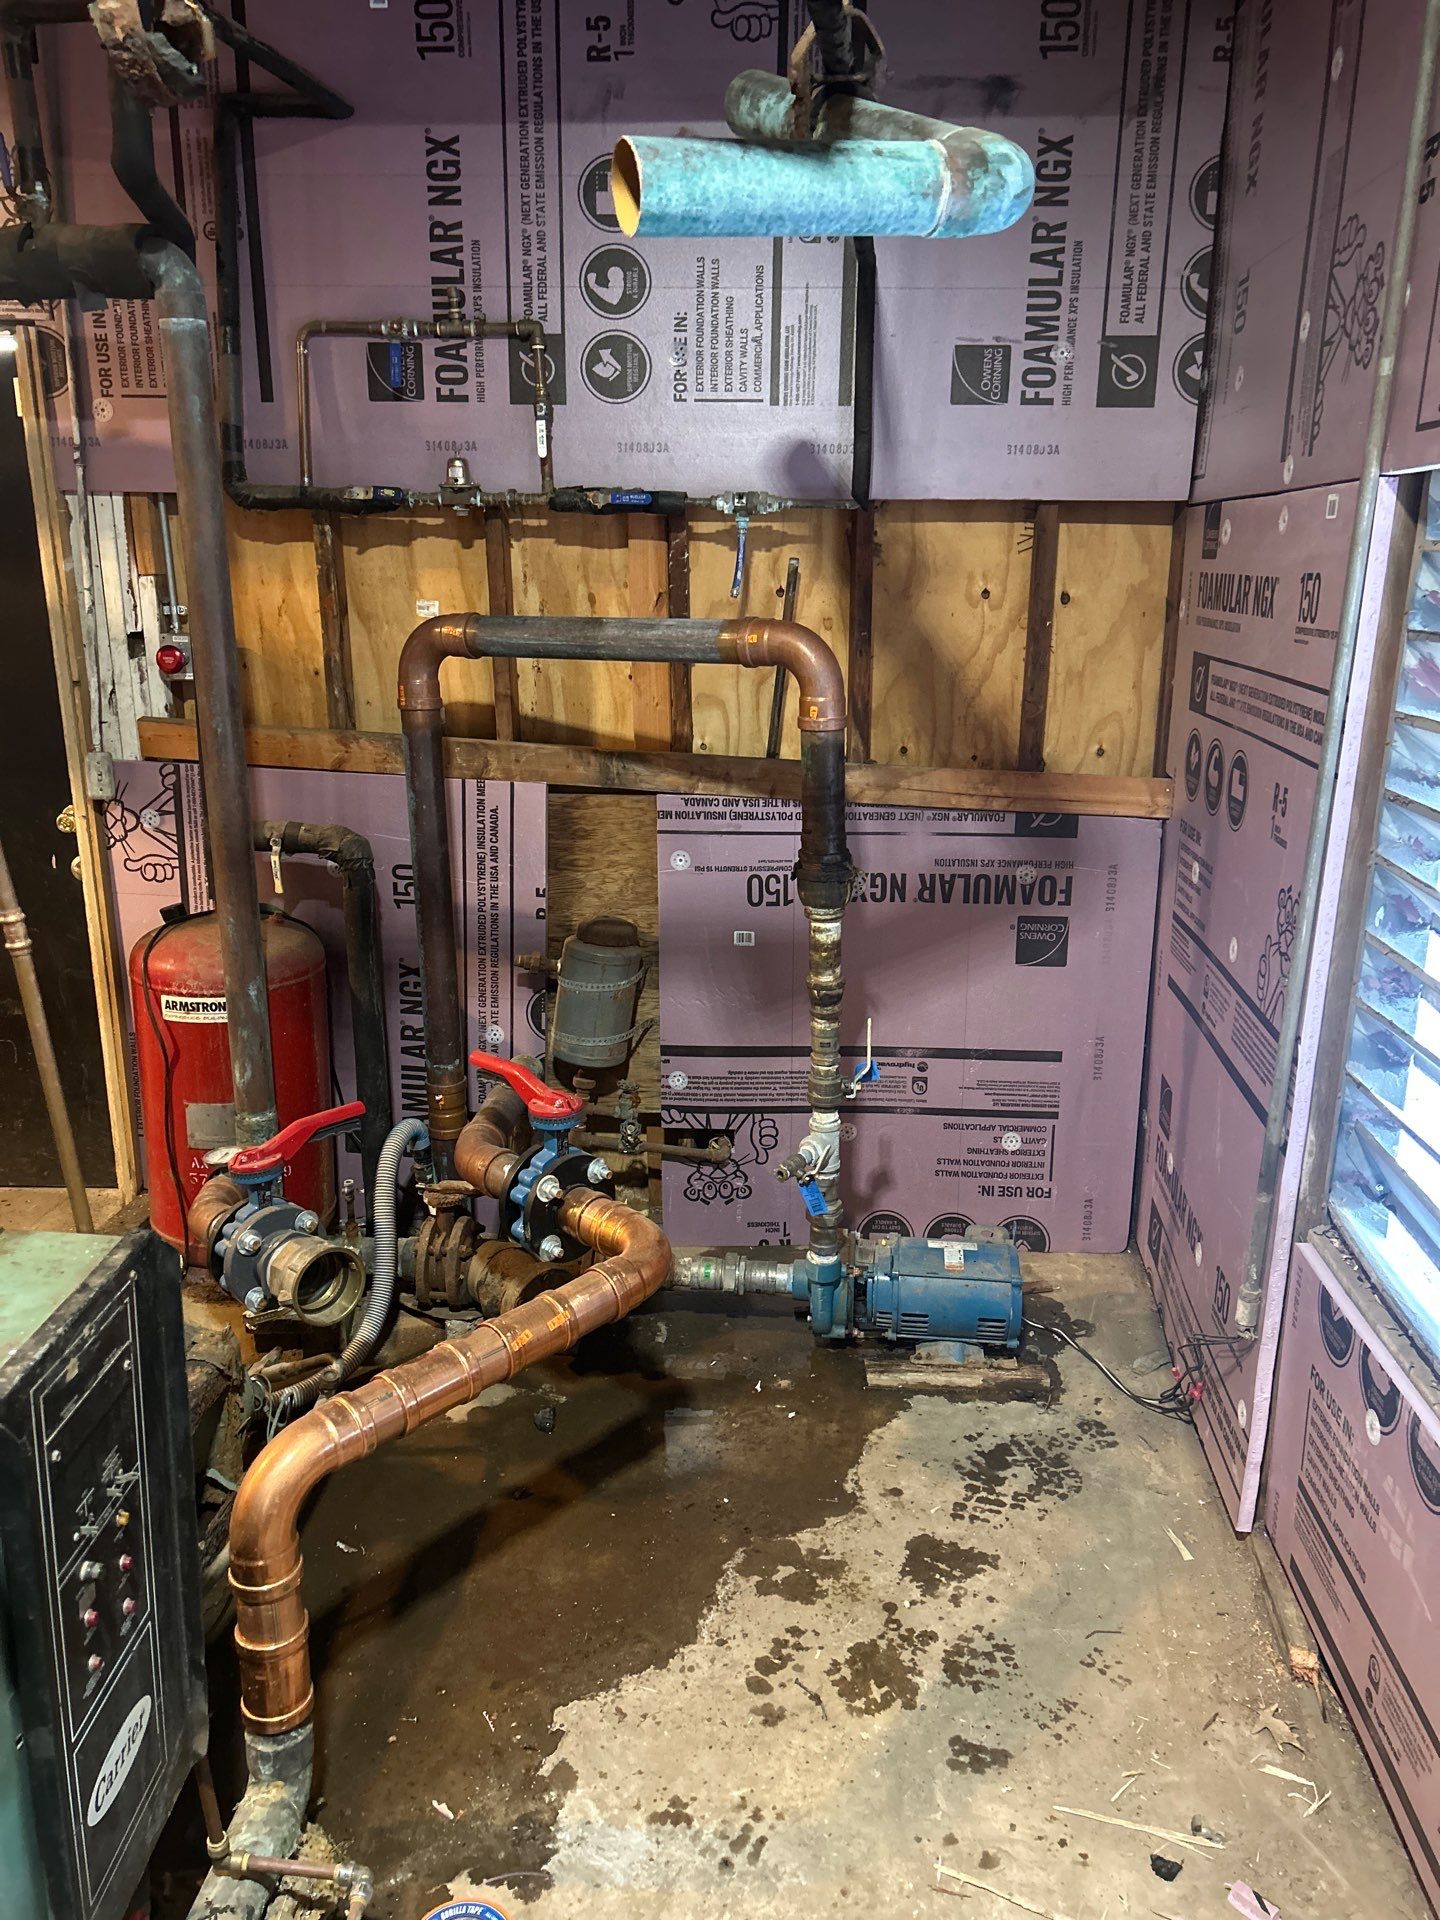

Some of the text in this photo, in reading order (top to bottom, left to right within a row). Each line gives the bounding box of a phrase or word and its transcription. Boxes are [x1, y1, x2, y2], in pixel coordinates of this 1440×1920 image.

[414, 0, 454, 60] 150
[586, 15, 611, 63] R-5
[516, 60, 529, 118] EXTRUDED
[531, 56, 544, 133] REGULATIONS
[518, 120, 531, 190] GENERATION
[533, 136, 545, 190] EMISSION
[1130, 119, 1148, 190] GENERATION
[1146, 136, 1161, 190] EMISSION
[535, 192, 546, 228] STATE
[1142, 191, 1156, 228] STATE
[536, 229, 546, 252] AND
[1139, 230, 1152, 253] AND
[471, 239, 482, 293] INSULATION
[536, 254, 548, 302] FEDERAL
[1135, 255, 1151, 302] FEDERAL
[537, 305, 548, 321] ALL
[695, 256, 705, 393] EXTERIOR FOUNDATION WALLS
[709, 258, 720, 393] INTERIOR FOUNDATION WALLS
[752, 264, 764, 393] COMMERCIAL APPLICATIONS
[1060, 239, 1083, 407] HIGH XPS INSULATION
[1133, 305, 1146, 324] ALL
[94, 332, 114, 398] FOR USE
[724, 296, 734, 393] EXTERIOR SHEATHING
[738, 327, 749, 393] CAVITY WALLS
[117, 346, 130, 389] EXTERIOR
[131, 348, 144, 389] INTERIOR
[145, 346, 158, 389] EXTERIOR
[405, 345, 417, 397] CORNING
[673, 371, 687, 403] FOR
[981, 347, 993, 391] OWENS
[990, 348, 1004, 401] CORNING
[475, 380, 486, 403] HIGH
[1298, 572, 1321, 624] 150
[674, 809, 794, 821] POLYSTYRENE) INSULATION
[721, 798, 740, 808] AND
[740, 798, 760, 808] USA
[1272, 782, 1288, 818] R-5
[475, 798, 486, 849] INSULATION
[489, 845, 500, 864] AND
[489, 865, 500, 883] USA
[934, 858, 979, 868] INSULATION
[980, 858, 995, 868] XPS
[1055, 860, 1075, 870] HIGH
[475, 851, 488, 913] POLYSTYRENE)
[489, 884, 500, 900] THE
[746, 873, 794, 908] 150
[476, 914, 487, 956] EXTRUDED
[489, 912, 500, 969] REGULATIONS
[1019, 922, 1065, 933] CORNING
[1019, 932, 1057, 942] OWENS
[476, 958, 488, 1008] GENERATION
[489, 970, 500, 1009] EMISSION
[165, 999, 227, 1012] ARMSTRON
[942, 1122, 1047, 1133] COMMERCIAL APPLICATIONS
[936, 1157, 1045, 1168] INTERIOR FOUNDATION WALLS
[966, 1147, 1046, 1157] EXTERIOR SHEATHING
[934, 1169, 1045, 1180] EXTERIOR FOUNDATION WALLS
[977, 1185, 1051, 1199] FOR USE IN:
[94, 1707, 145, 1813] Carrier
